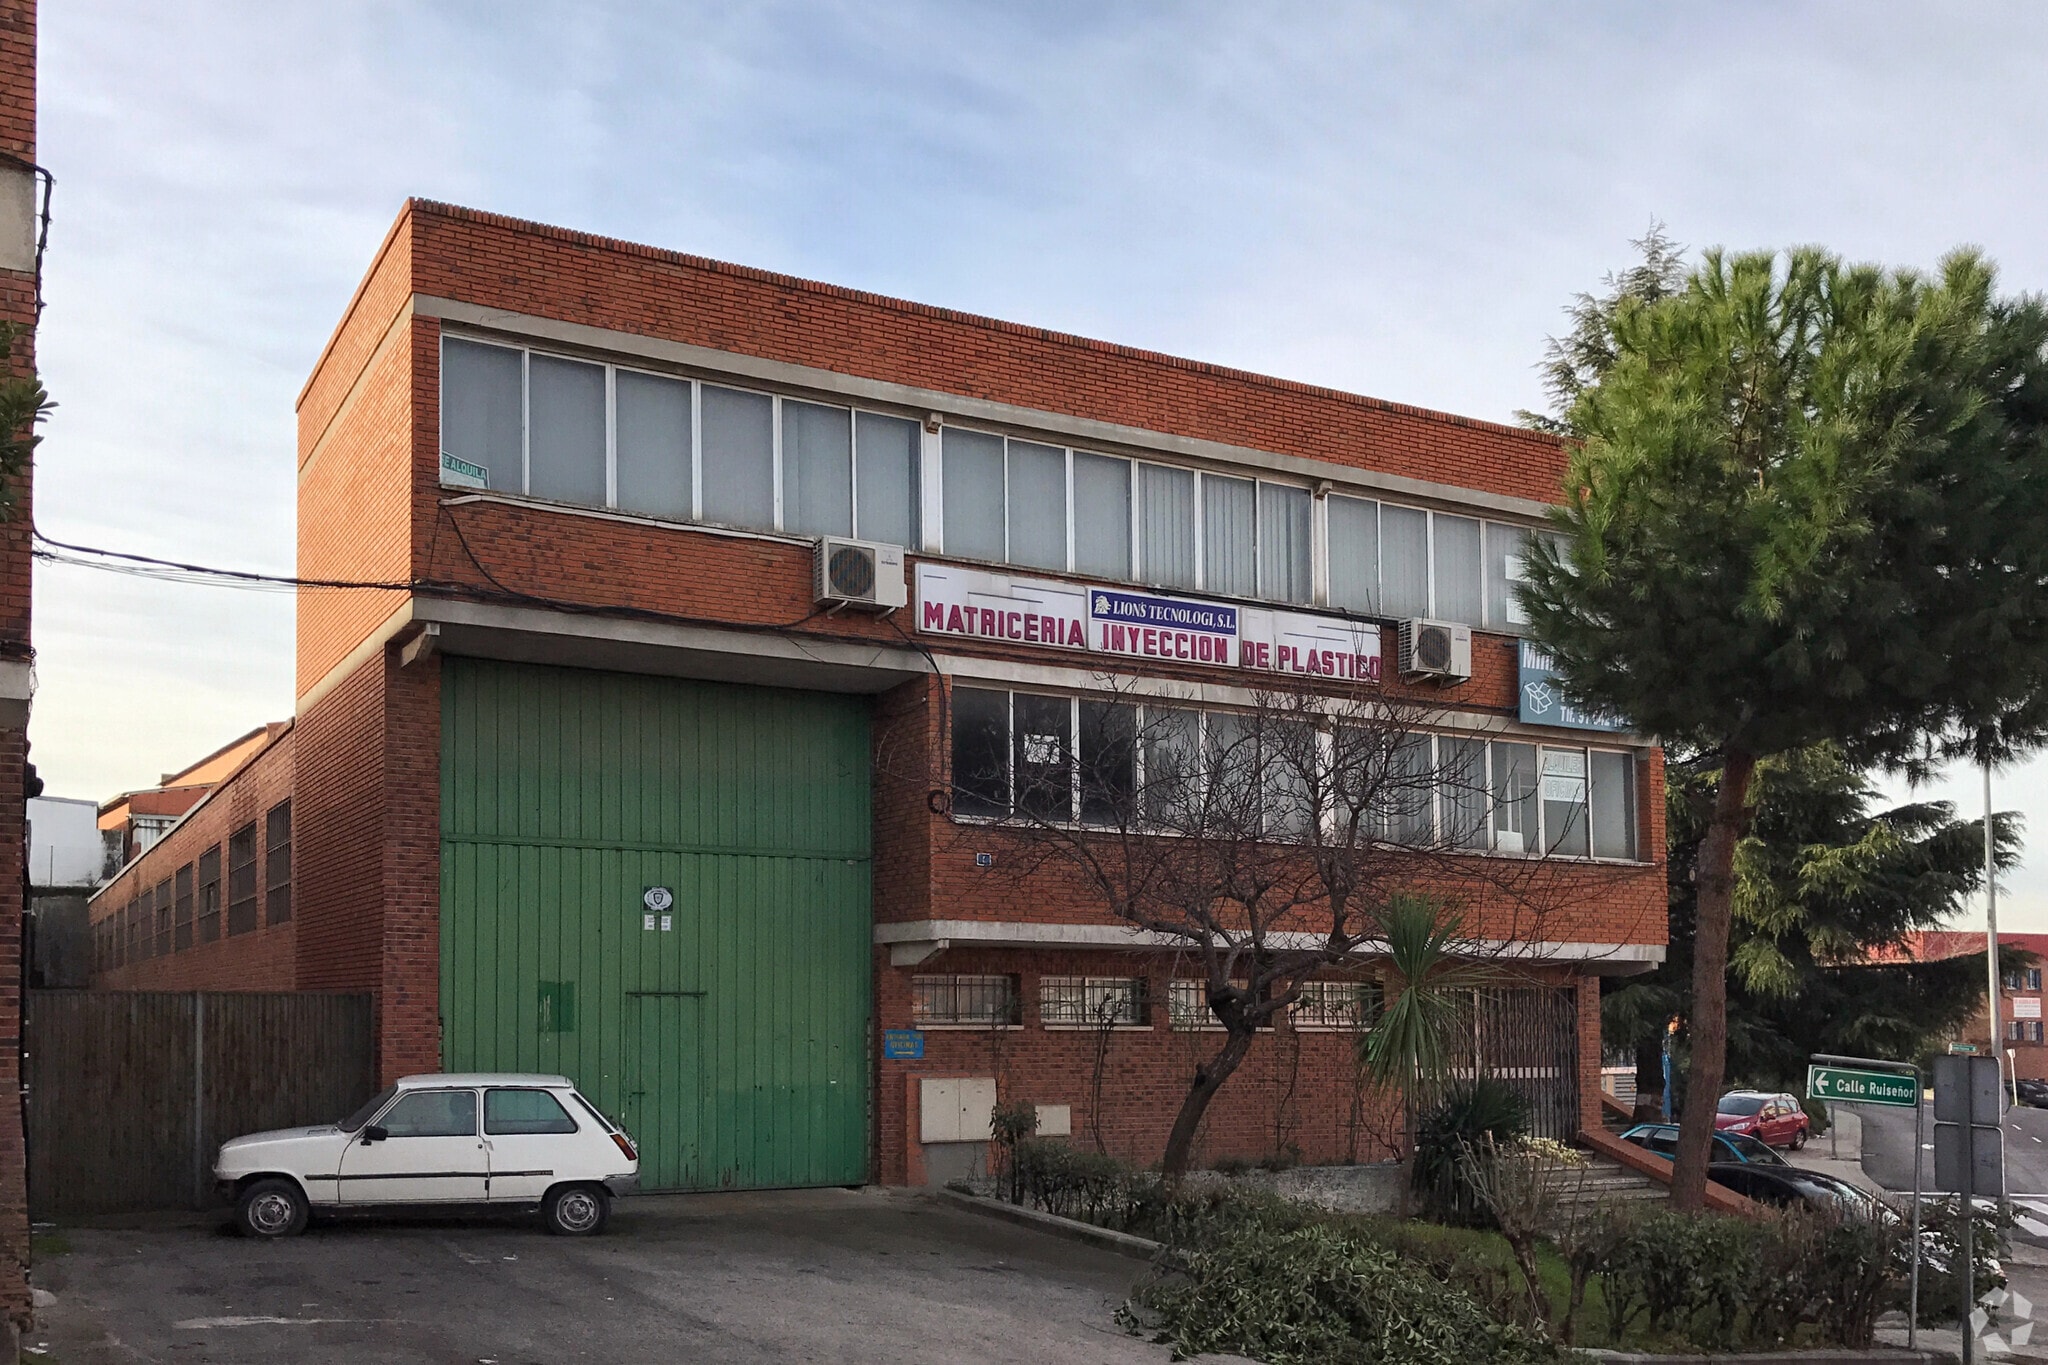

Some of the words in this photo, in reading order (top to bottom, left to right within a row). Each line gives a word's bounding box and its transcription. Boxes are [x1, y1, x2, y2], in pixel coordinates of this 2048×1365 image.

[450, 459, 487, 479] ALQUILA
[923, 600, 1085, 647] MATRICERIA
[1103, 623, 1228, 664] INYECCION
[1242, 640, 1269, 669] DE
[1278, 646, 1381, 680] PLASTICO
[1836, 1079, 1865, 1094] Calle
[1869, 1082, 1914, 1098] Ruiseñor
